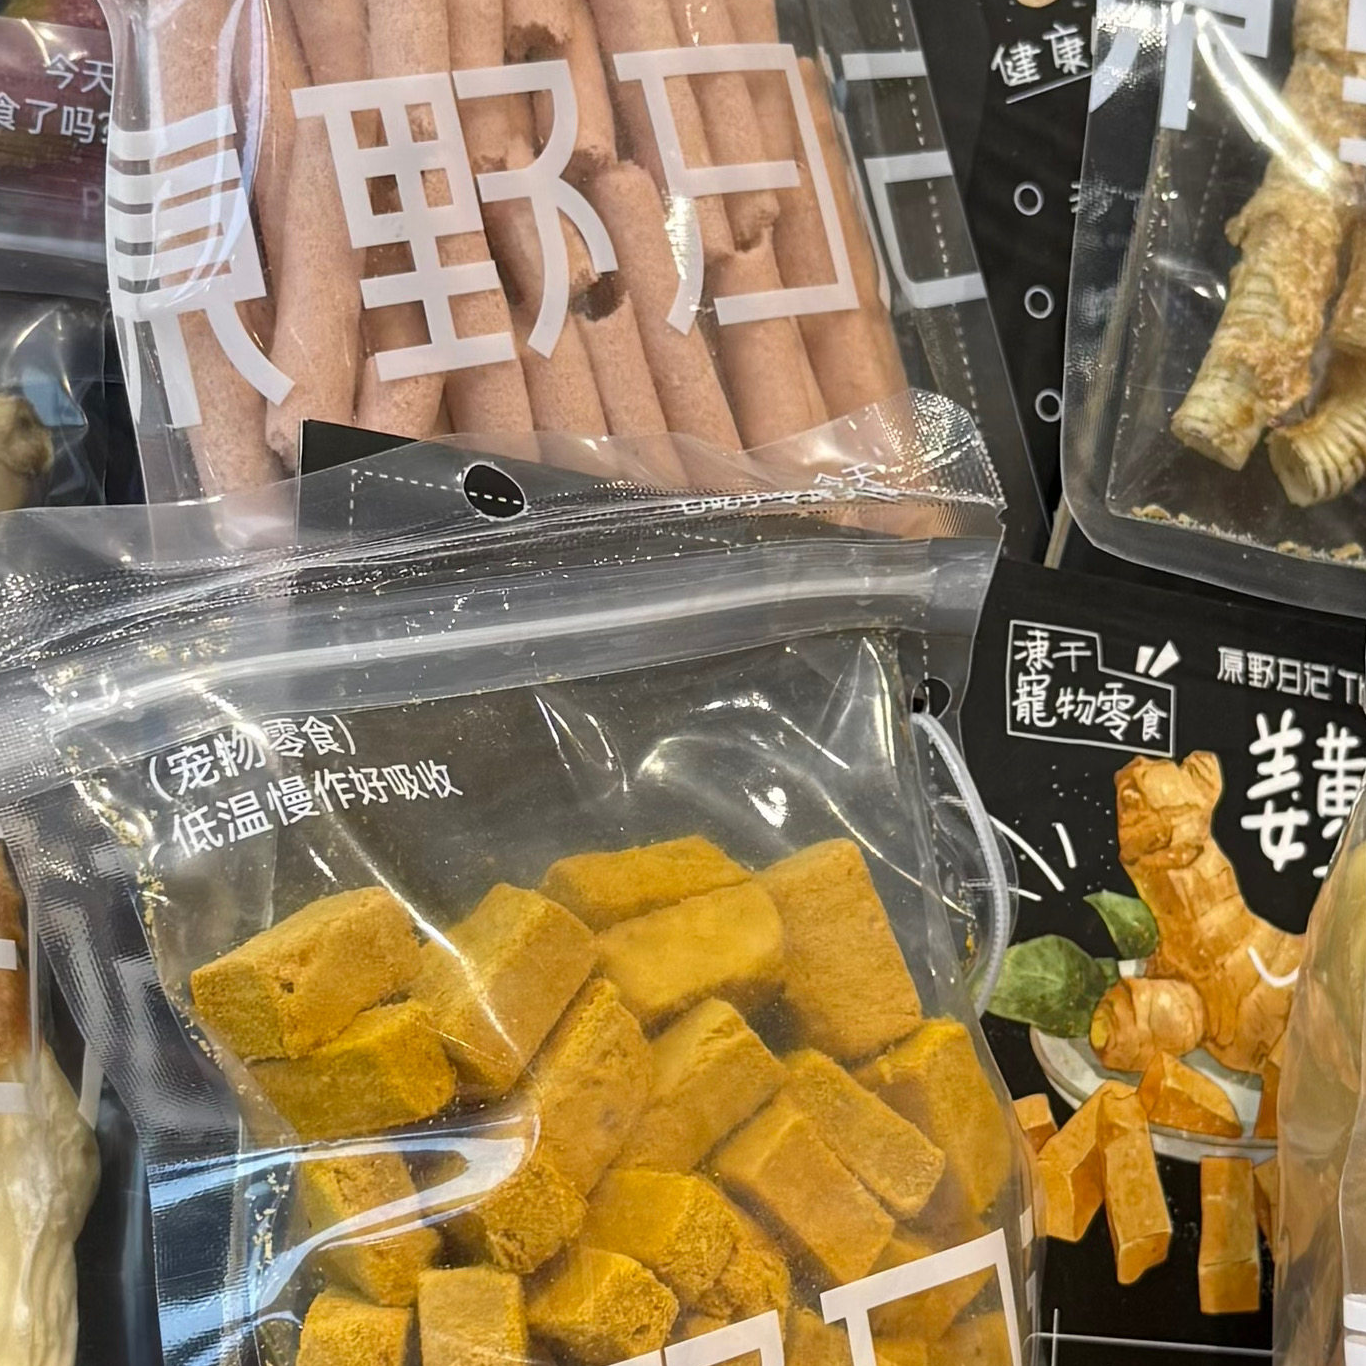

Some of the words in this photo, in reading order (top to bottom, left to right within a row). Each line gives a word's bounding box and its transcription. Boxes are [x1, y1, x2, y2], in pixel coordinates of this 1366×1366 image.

[45, 53, 115, 96] 今天
[1216, 646, 1334, 700] 原野日记
[147, 713, 357, 803] (宠物零食)
[169, 757, 464, 858] 低温慢作好吸收
